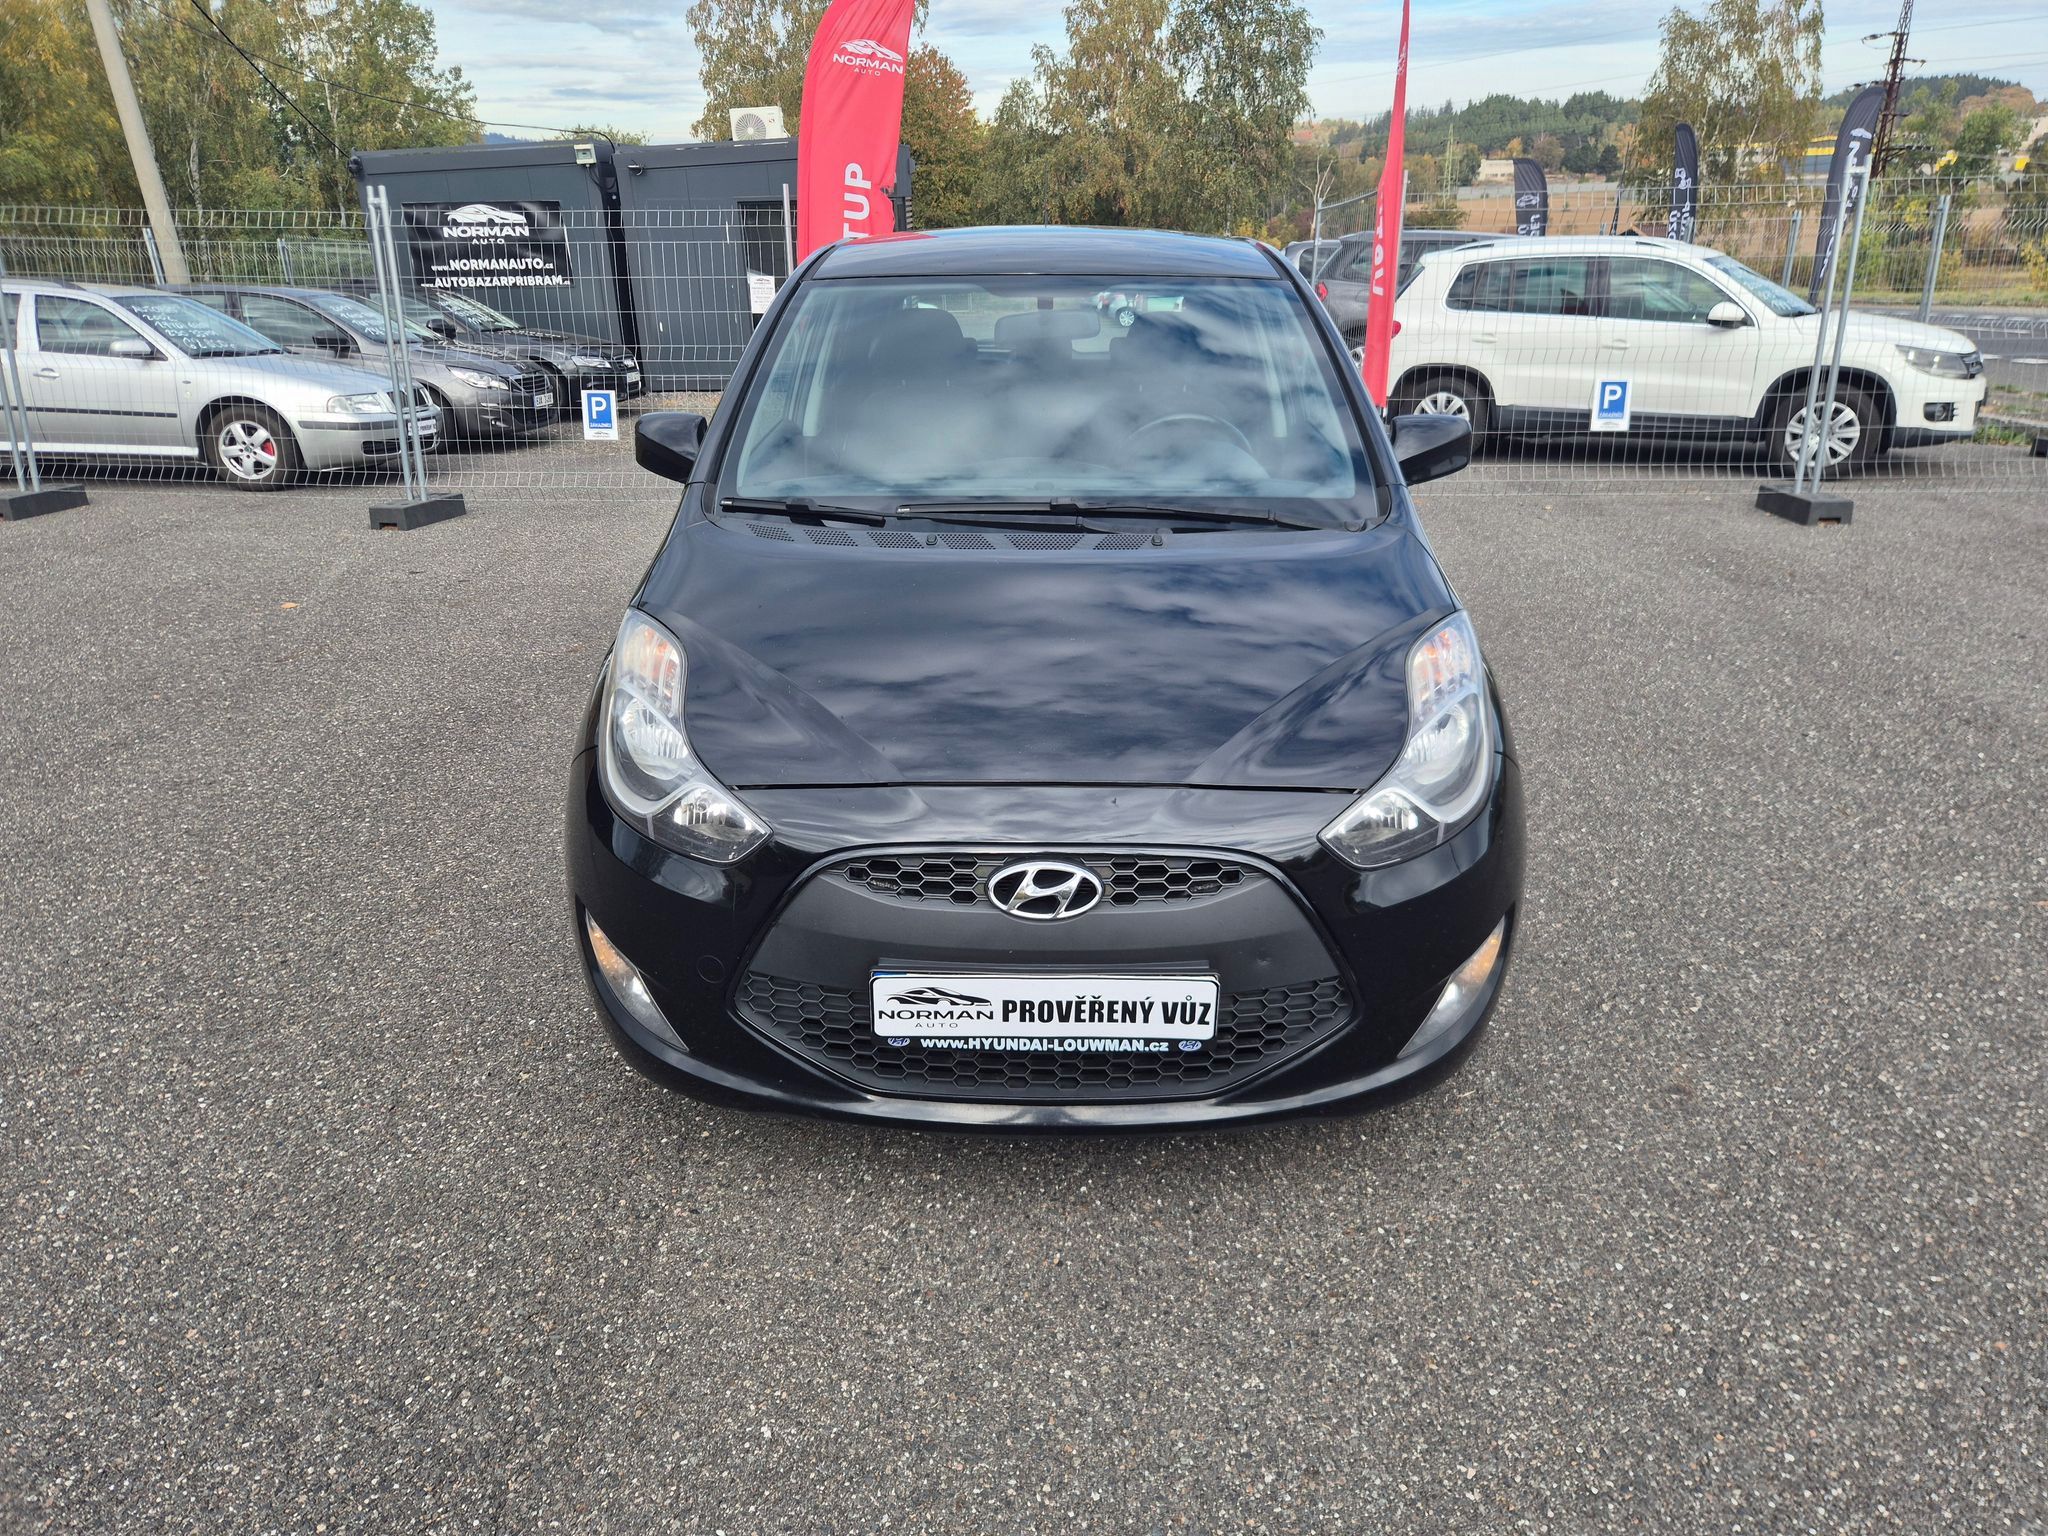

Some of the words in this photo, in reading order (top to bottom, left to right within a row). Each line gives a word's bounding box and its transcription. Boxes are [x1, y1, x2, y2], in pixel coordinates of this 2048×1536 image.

[833, 53, 904, 75] NORMAN
[854, 67, 881, 77] AUTO
[443, 226, 530, 237] NORMAN
[590, 396, 607, 420] P
[1603, 385, 1622, 409] P
[879, 1010, 994, 1020] NORMAN
[1002, 995, 1155, 1024] PROVĚŘENÝ
[1162, 995, 1212, 1026] VŮZ
[920, 1037, 1169, 1051] www.HYUNDAI-LOUWMAN.cz
